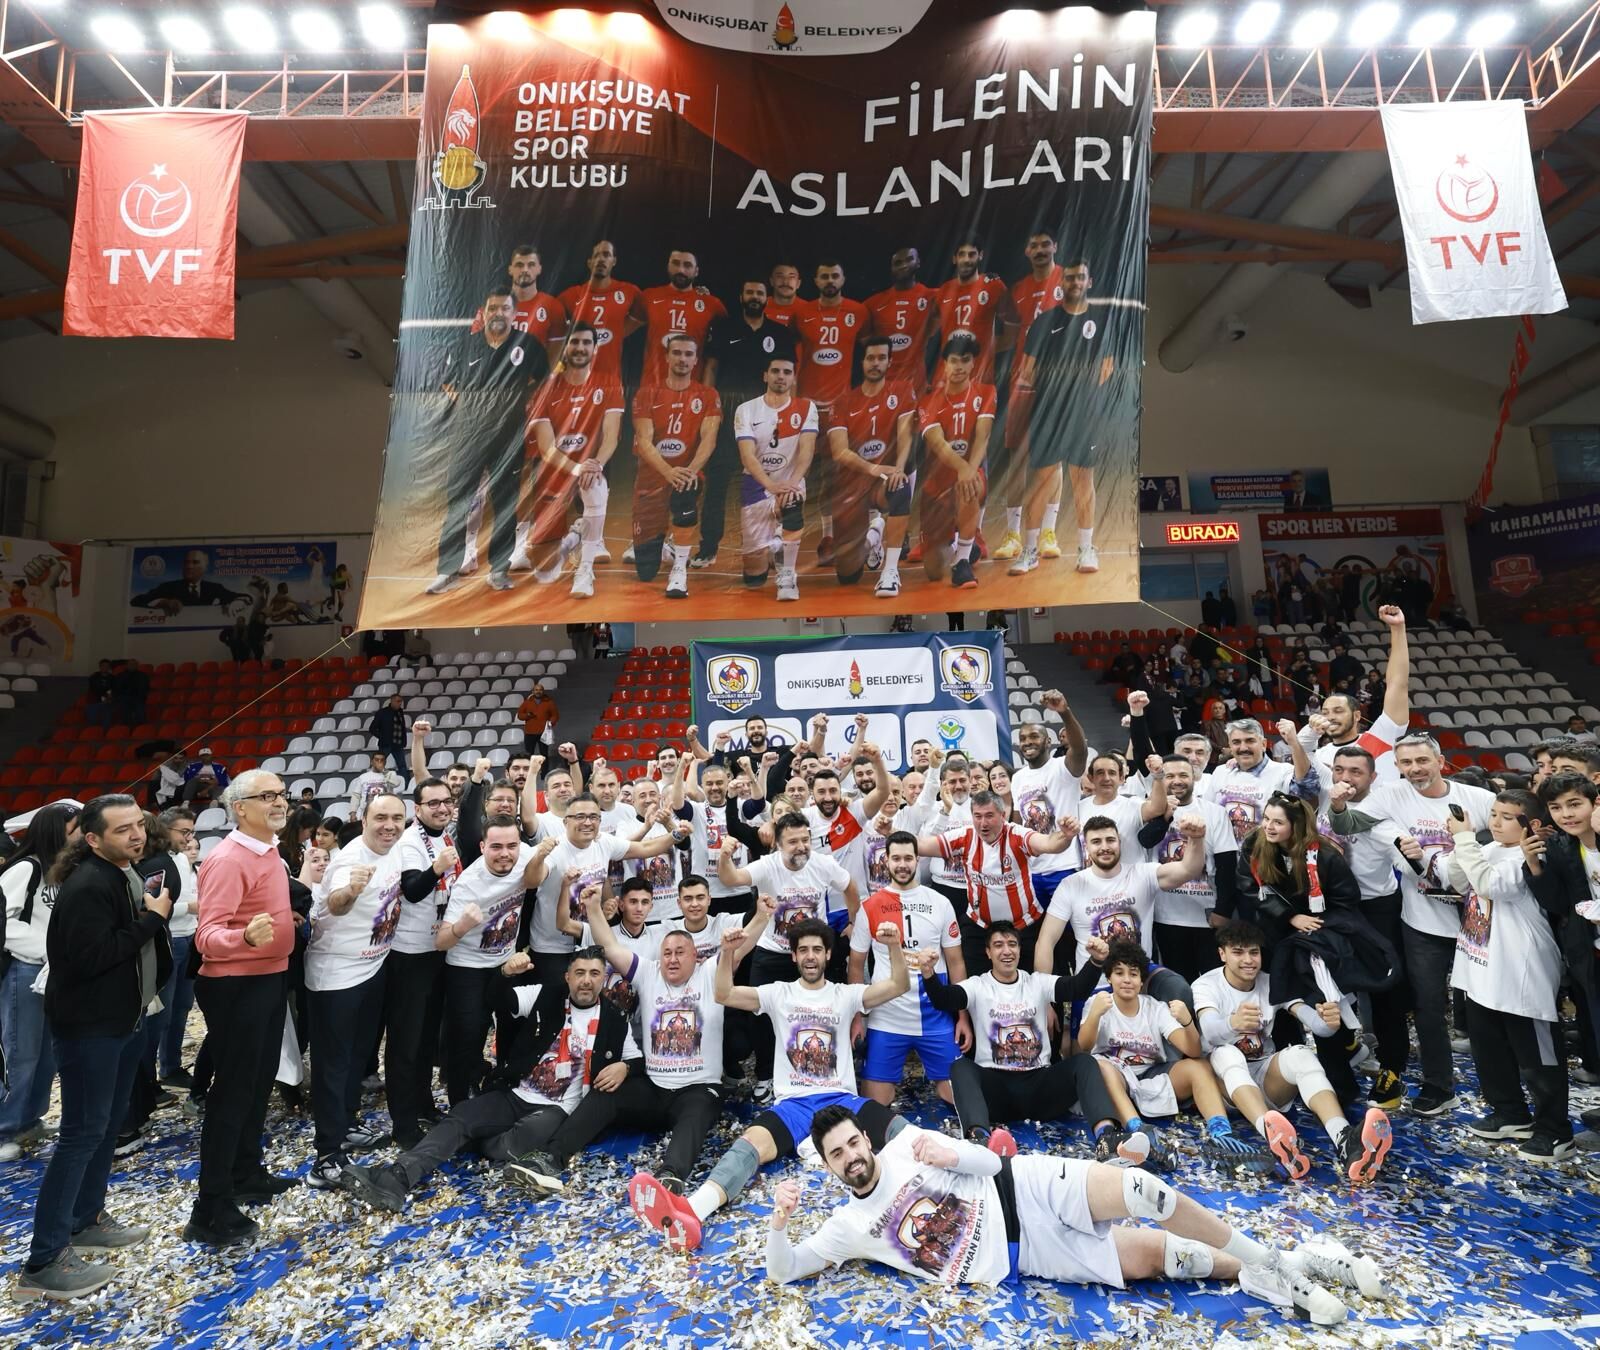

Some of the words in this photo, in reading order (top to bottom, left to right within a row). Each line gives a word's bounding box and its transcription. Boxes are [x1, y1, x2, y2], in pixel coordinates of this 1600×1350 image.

[864, 53, 1136, 143] FİLENİN
[512, 135, 589, 161] SPOR
[510, 164, 628, 189] KULÜBÜ
[736, 136, 1132, 217] ASLANLARI
[1430, 231, 1521, 270] TVF
[102, 248, 203, 286] TVF
[593, 306, 605, 325] 2
[669, 309, 687, 329] 14
[896, 310, 906, 329] 5
[954, 304, 972, 326] 12
[819, 325, 839, 345] 20
[818, 351, 839, 360] MADO
[570, 406, 582, 429] 7
[667, 412, 682, 435] 16
[871, 415, 876, 436] 1
[953, 412, 966, 435] 11
[561, 436, 584, 448] MADO
[661, 442, 682, 452] MADO
[769, 428, 779, 449] 3
[863, 443, 883, 454] MADO
[761, 457, 784, 466] MADO
[1170, 525, 1238, 541] BURADA
[1267, 519, 1309, 536] SPOR
[1312, 518, 1344, 534] HER
[1345, 516, 1398, 532] YERDE
[819, 832, 832, 847] 14
[905, 914, 913, 938] 1
[901, 940, 919, 949] ALP
